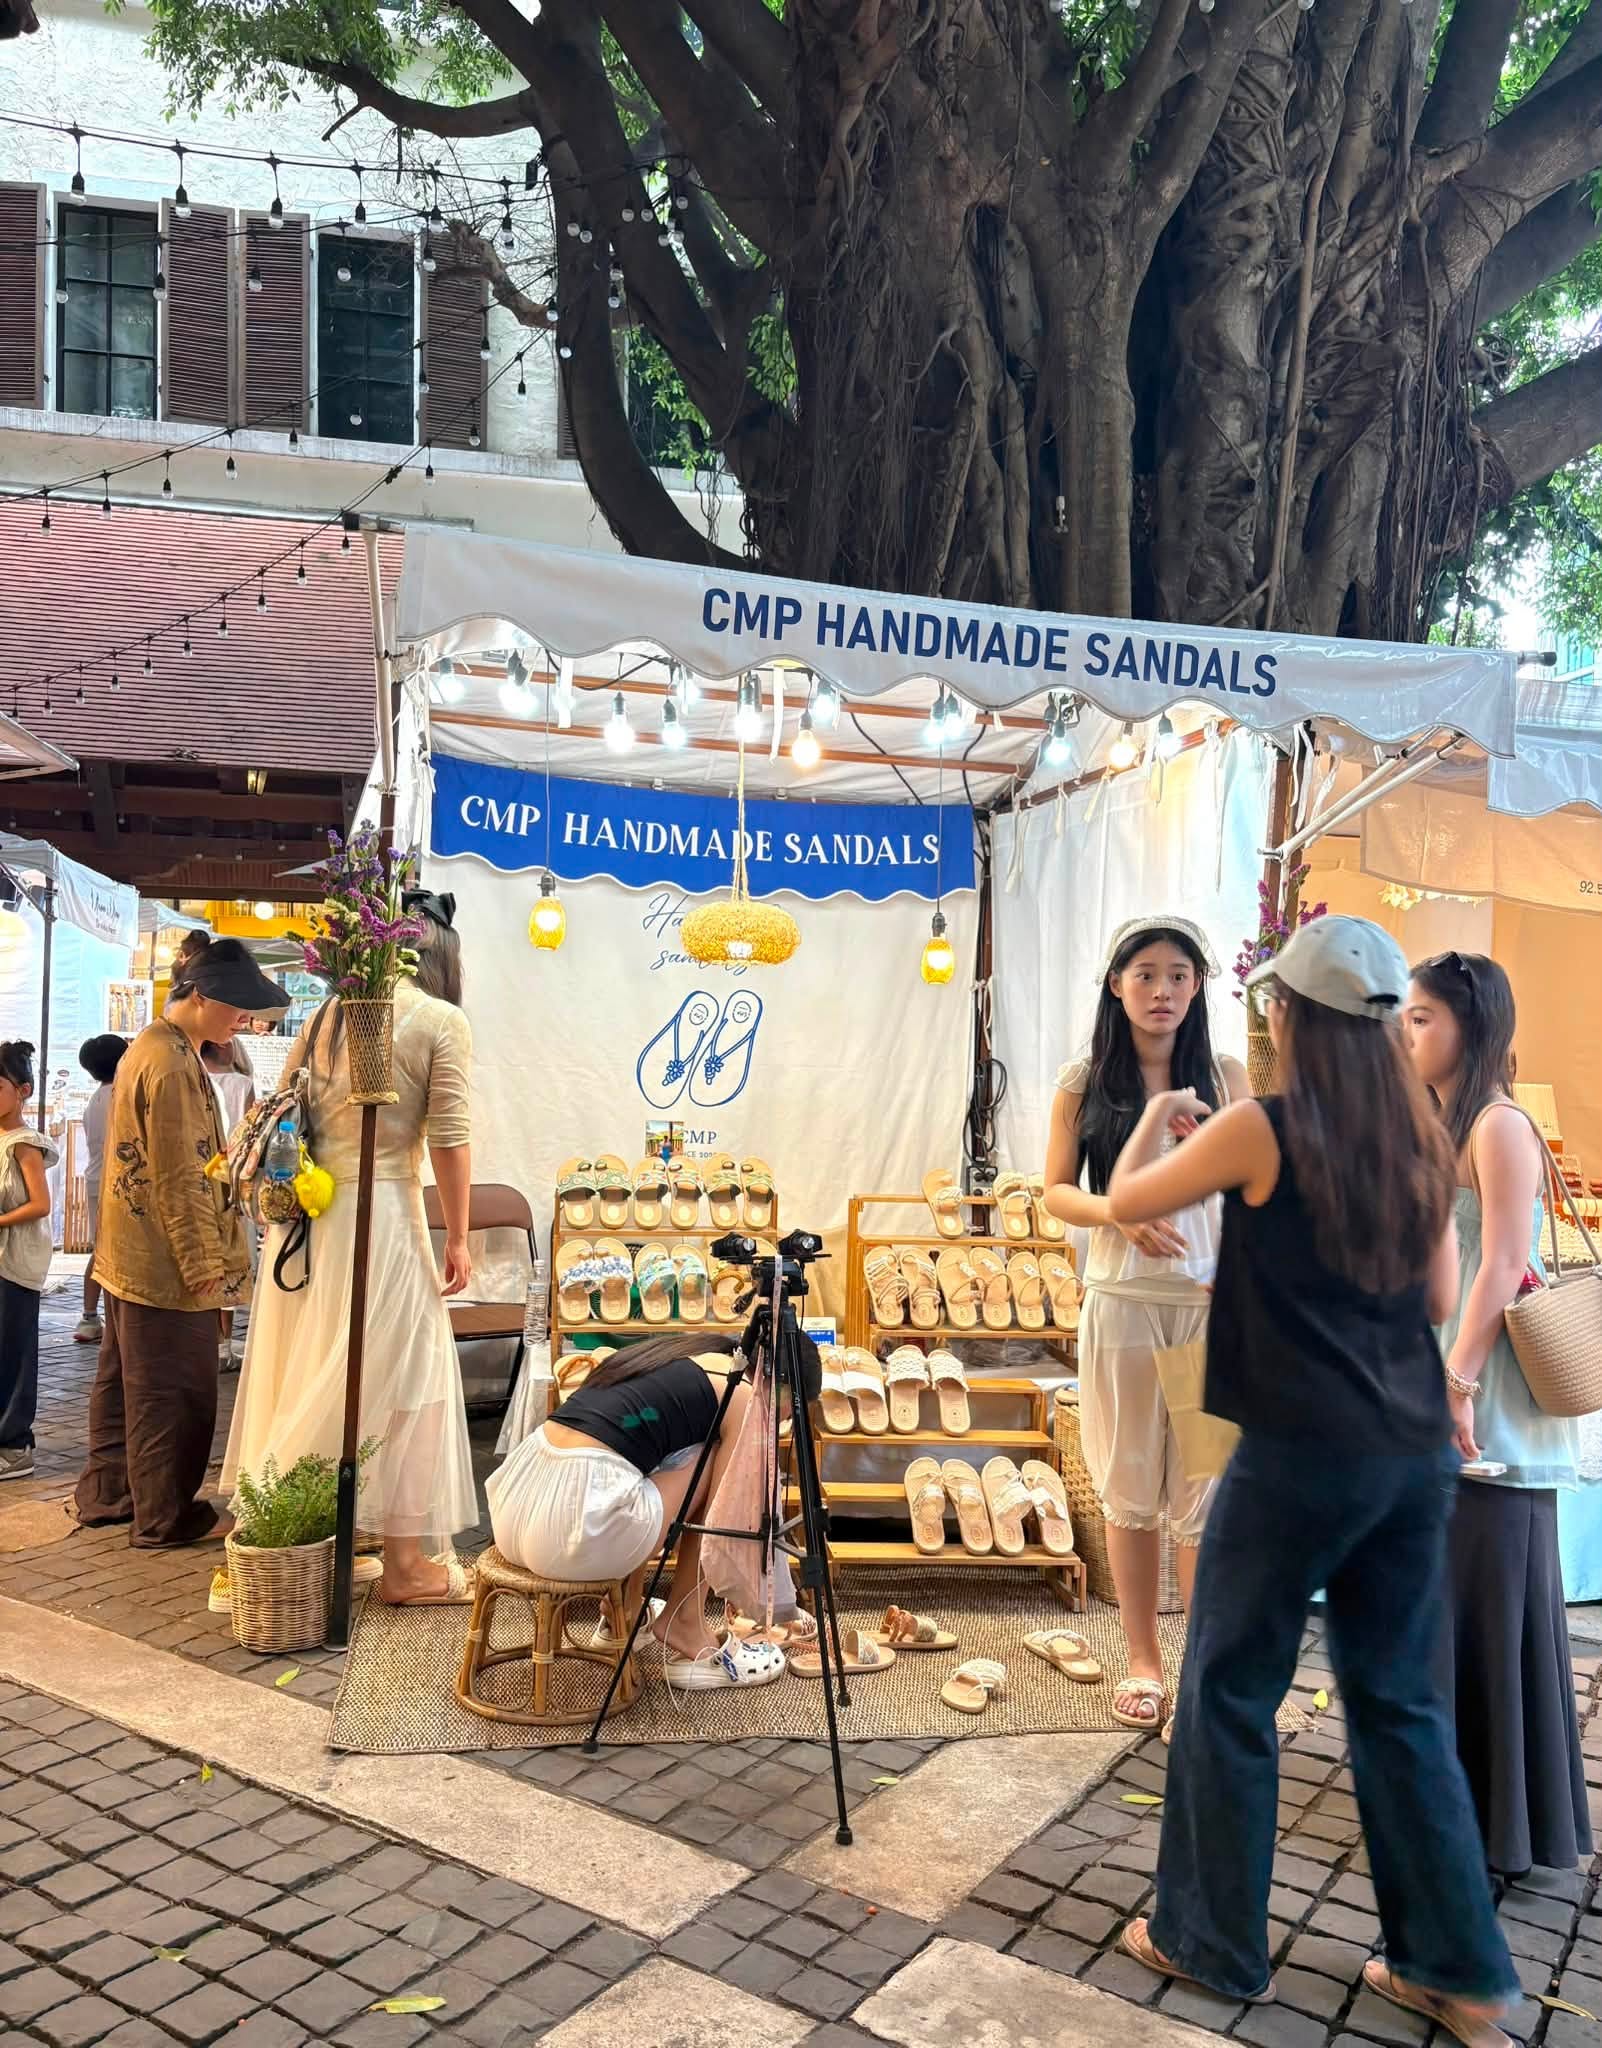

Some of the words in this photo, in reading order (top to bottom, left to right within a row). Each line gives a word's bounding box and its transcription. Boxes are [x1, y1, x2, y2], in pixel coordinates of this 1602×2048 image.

[702, 587, 802, 641] CMP
[816, 601, 1070, 671] HANDMADE
[1083, 632, 1279, 698] SANDALS
[460, 795, 541, 837] CMP
[563, 812, 774, 862] HANDMADE
[783, 833, 940, 866] SANDALS
